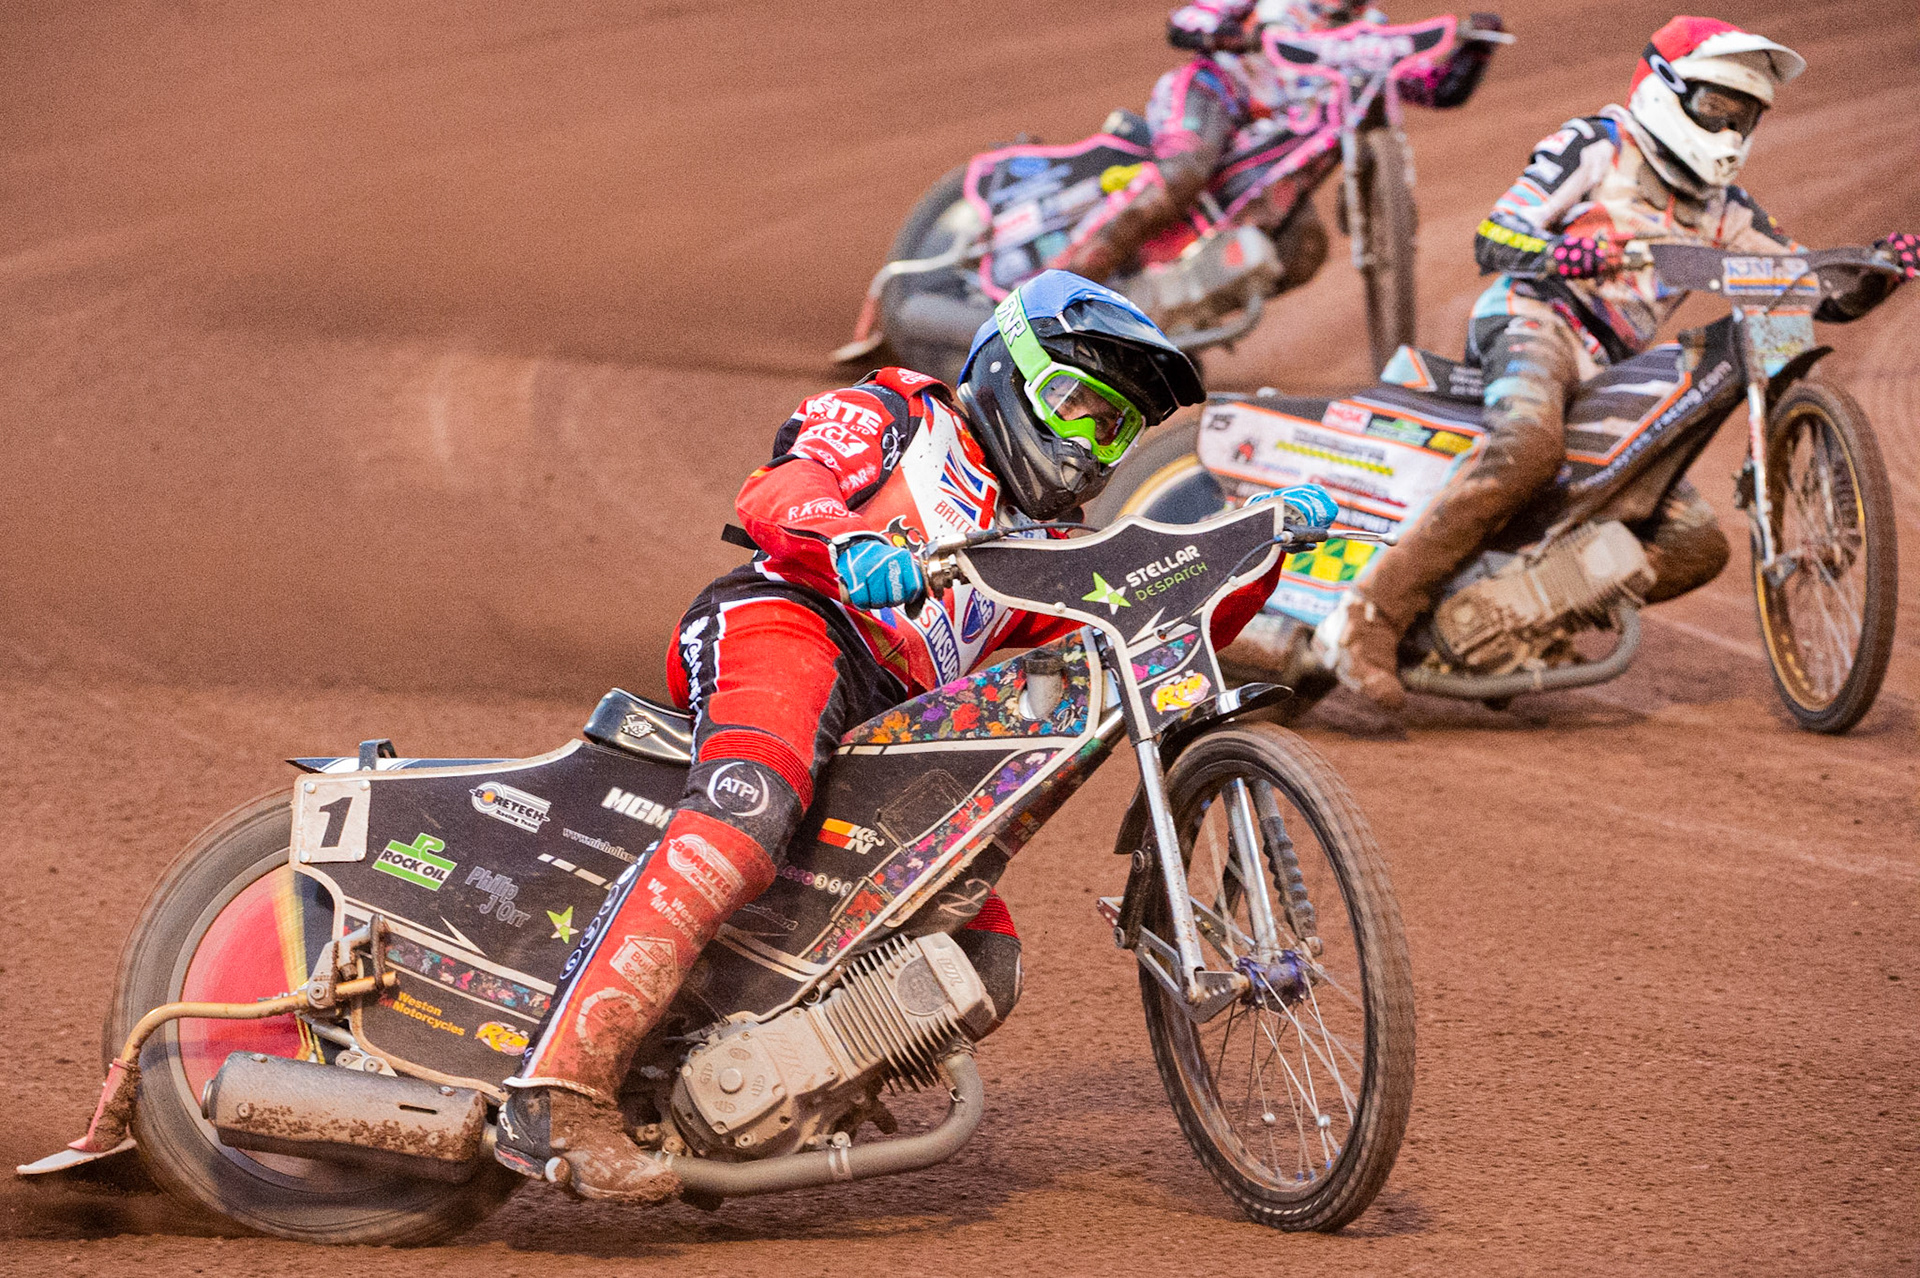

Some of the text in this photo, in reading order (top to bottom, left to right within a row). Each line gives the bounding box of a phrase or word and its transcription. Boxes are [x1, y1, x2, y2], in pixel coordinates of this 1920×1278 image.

[1125, 545, 1201, 588] STELLAR
[1135, 561, 1209, 601] DESPATCH
[717, 776, 760, 803] ATPI
[319, 796, 353, 848] 1
[601, 786, 672, 830] MCM
[380, 849, 448, 881] ROCK OIL
[495, 900, 532, 928] Orr
[392, 1001, 466, 1037] Motorcycles
[398, 991, 443, 1017] Weston
